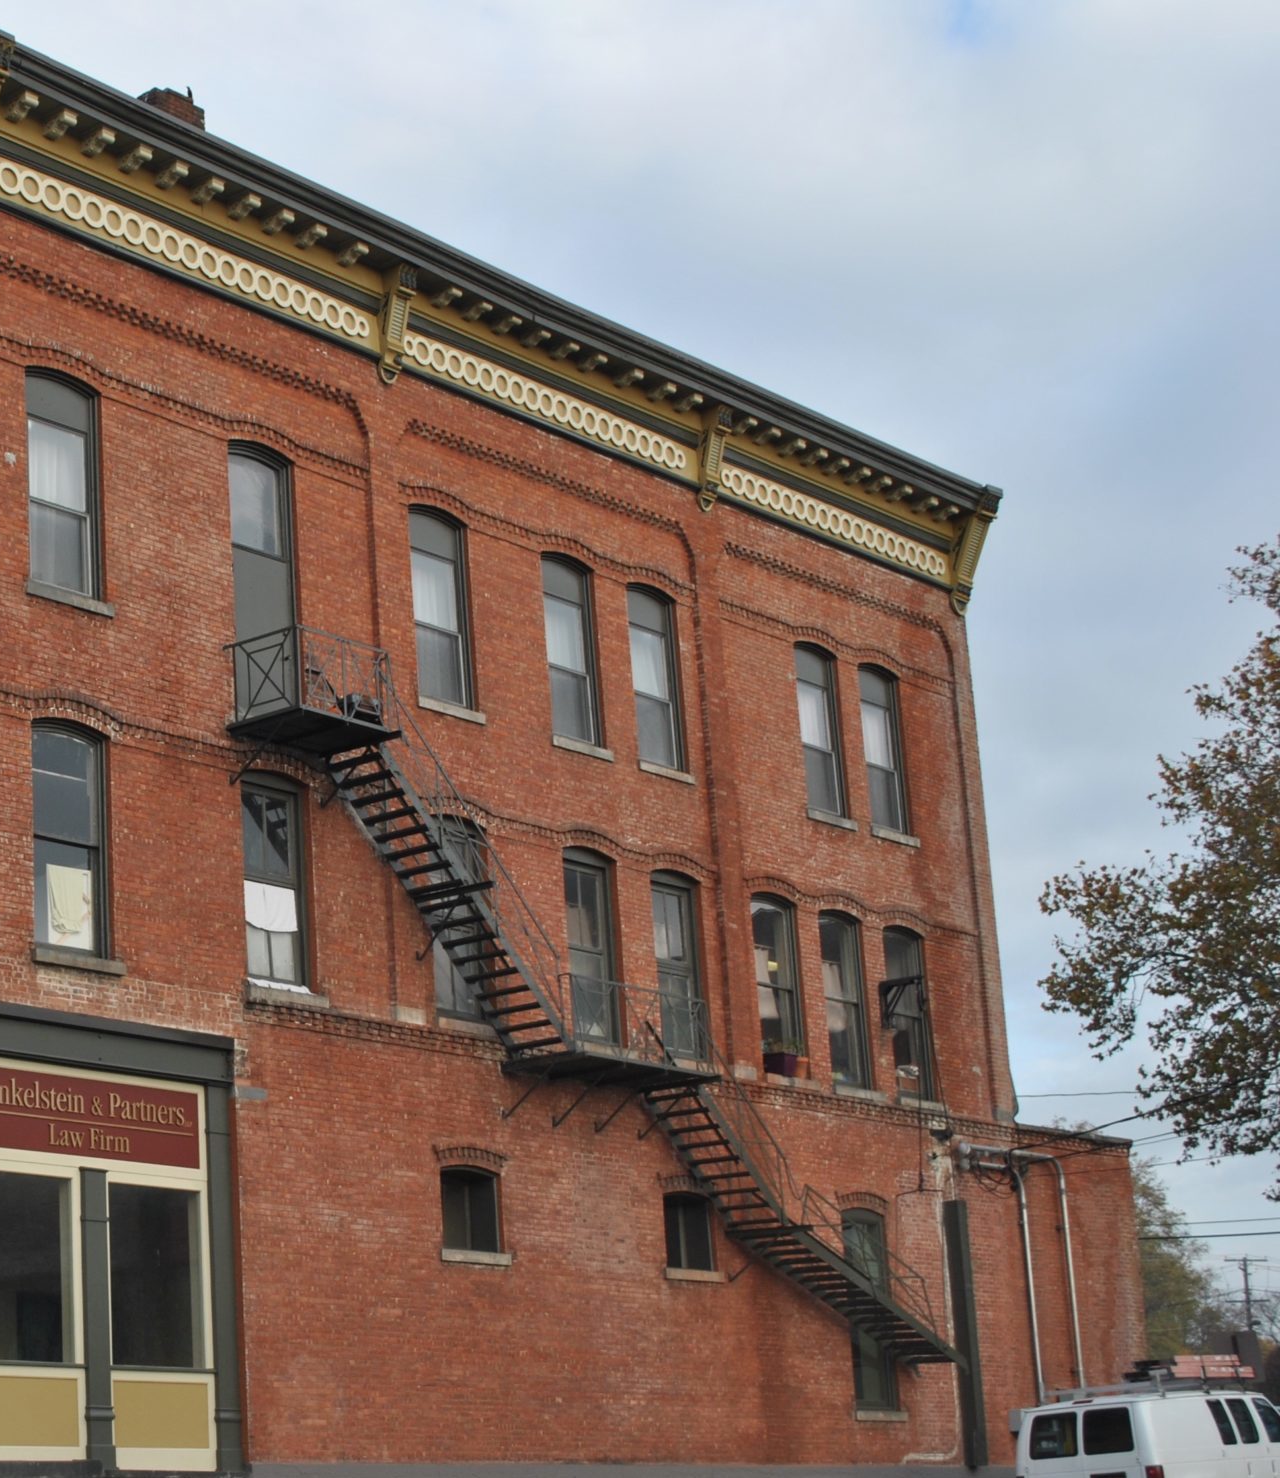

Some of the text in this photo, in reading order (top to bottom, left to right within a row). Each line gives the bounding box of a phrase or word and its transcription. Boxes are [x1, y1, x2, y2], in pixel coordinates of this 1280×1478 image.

[91, 1096, 104, 1117] &
[108, 1092, 185, 1127] Partners
[48, 1123, 131, 1153] Law Firm
